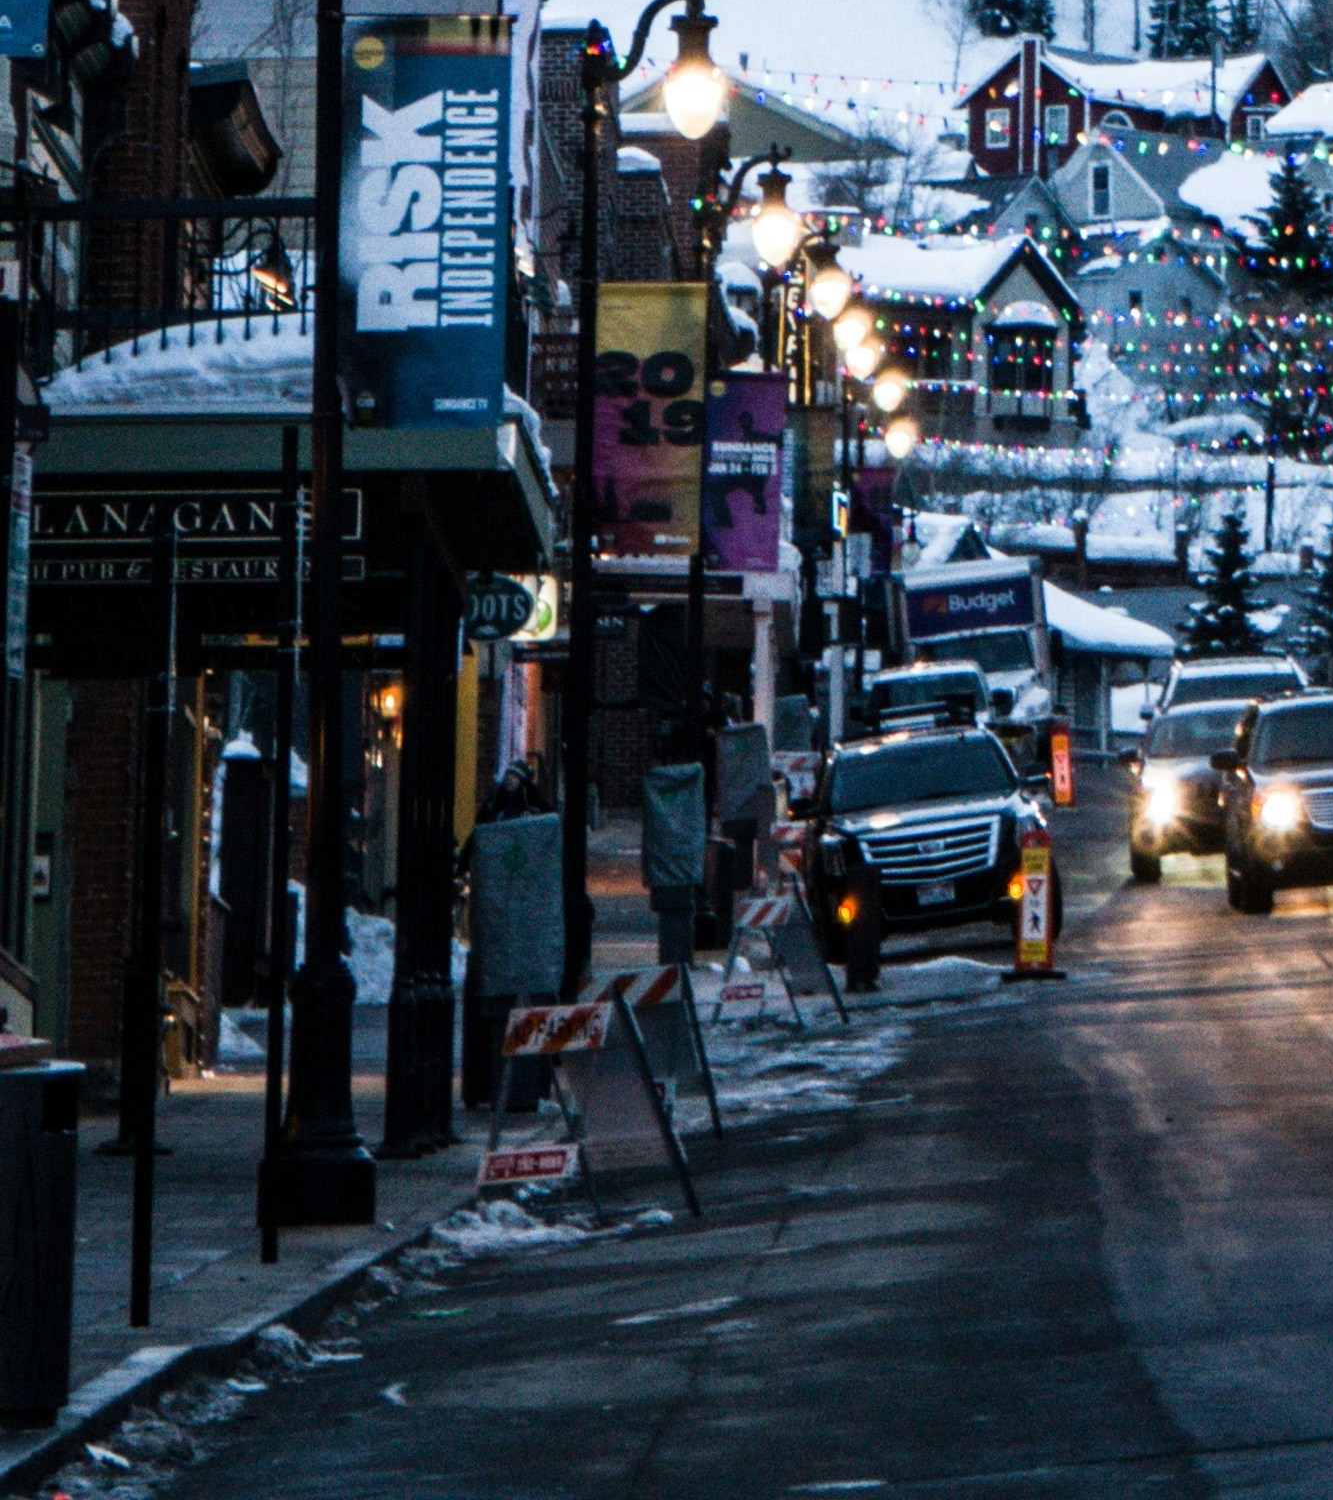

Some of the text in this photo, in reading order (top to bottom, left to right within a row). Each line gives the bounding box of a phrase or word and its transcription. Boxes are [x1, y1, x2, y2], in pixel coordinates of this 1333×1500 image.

[356, 90, 443, 332] RISK
[441, 89, 499, 327] INDEPENDENCE
[595, 351, 694, 397] 20
[619, 400, 704, 445] 19
[61, 563, 114, 580] PUB
[468, 593, 527, 622] OOTS
[949, 590, 1015, 614] Budget
